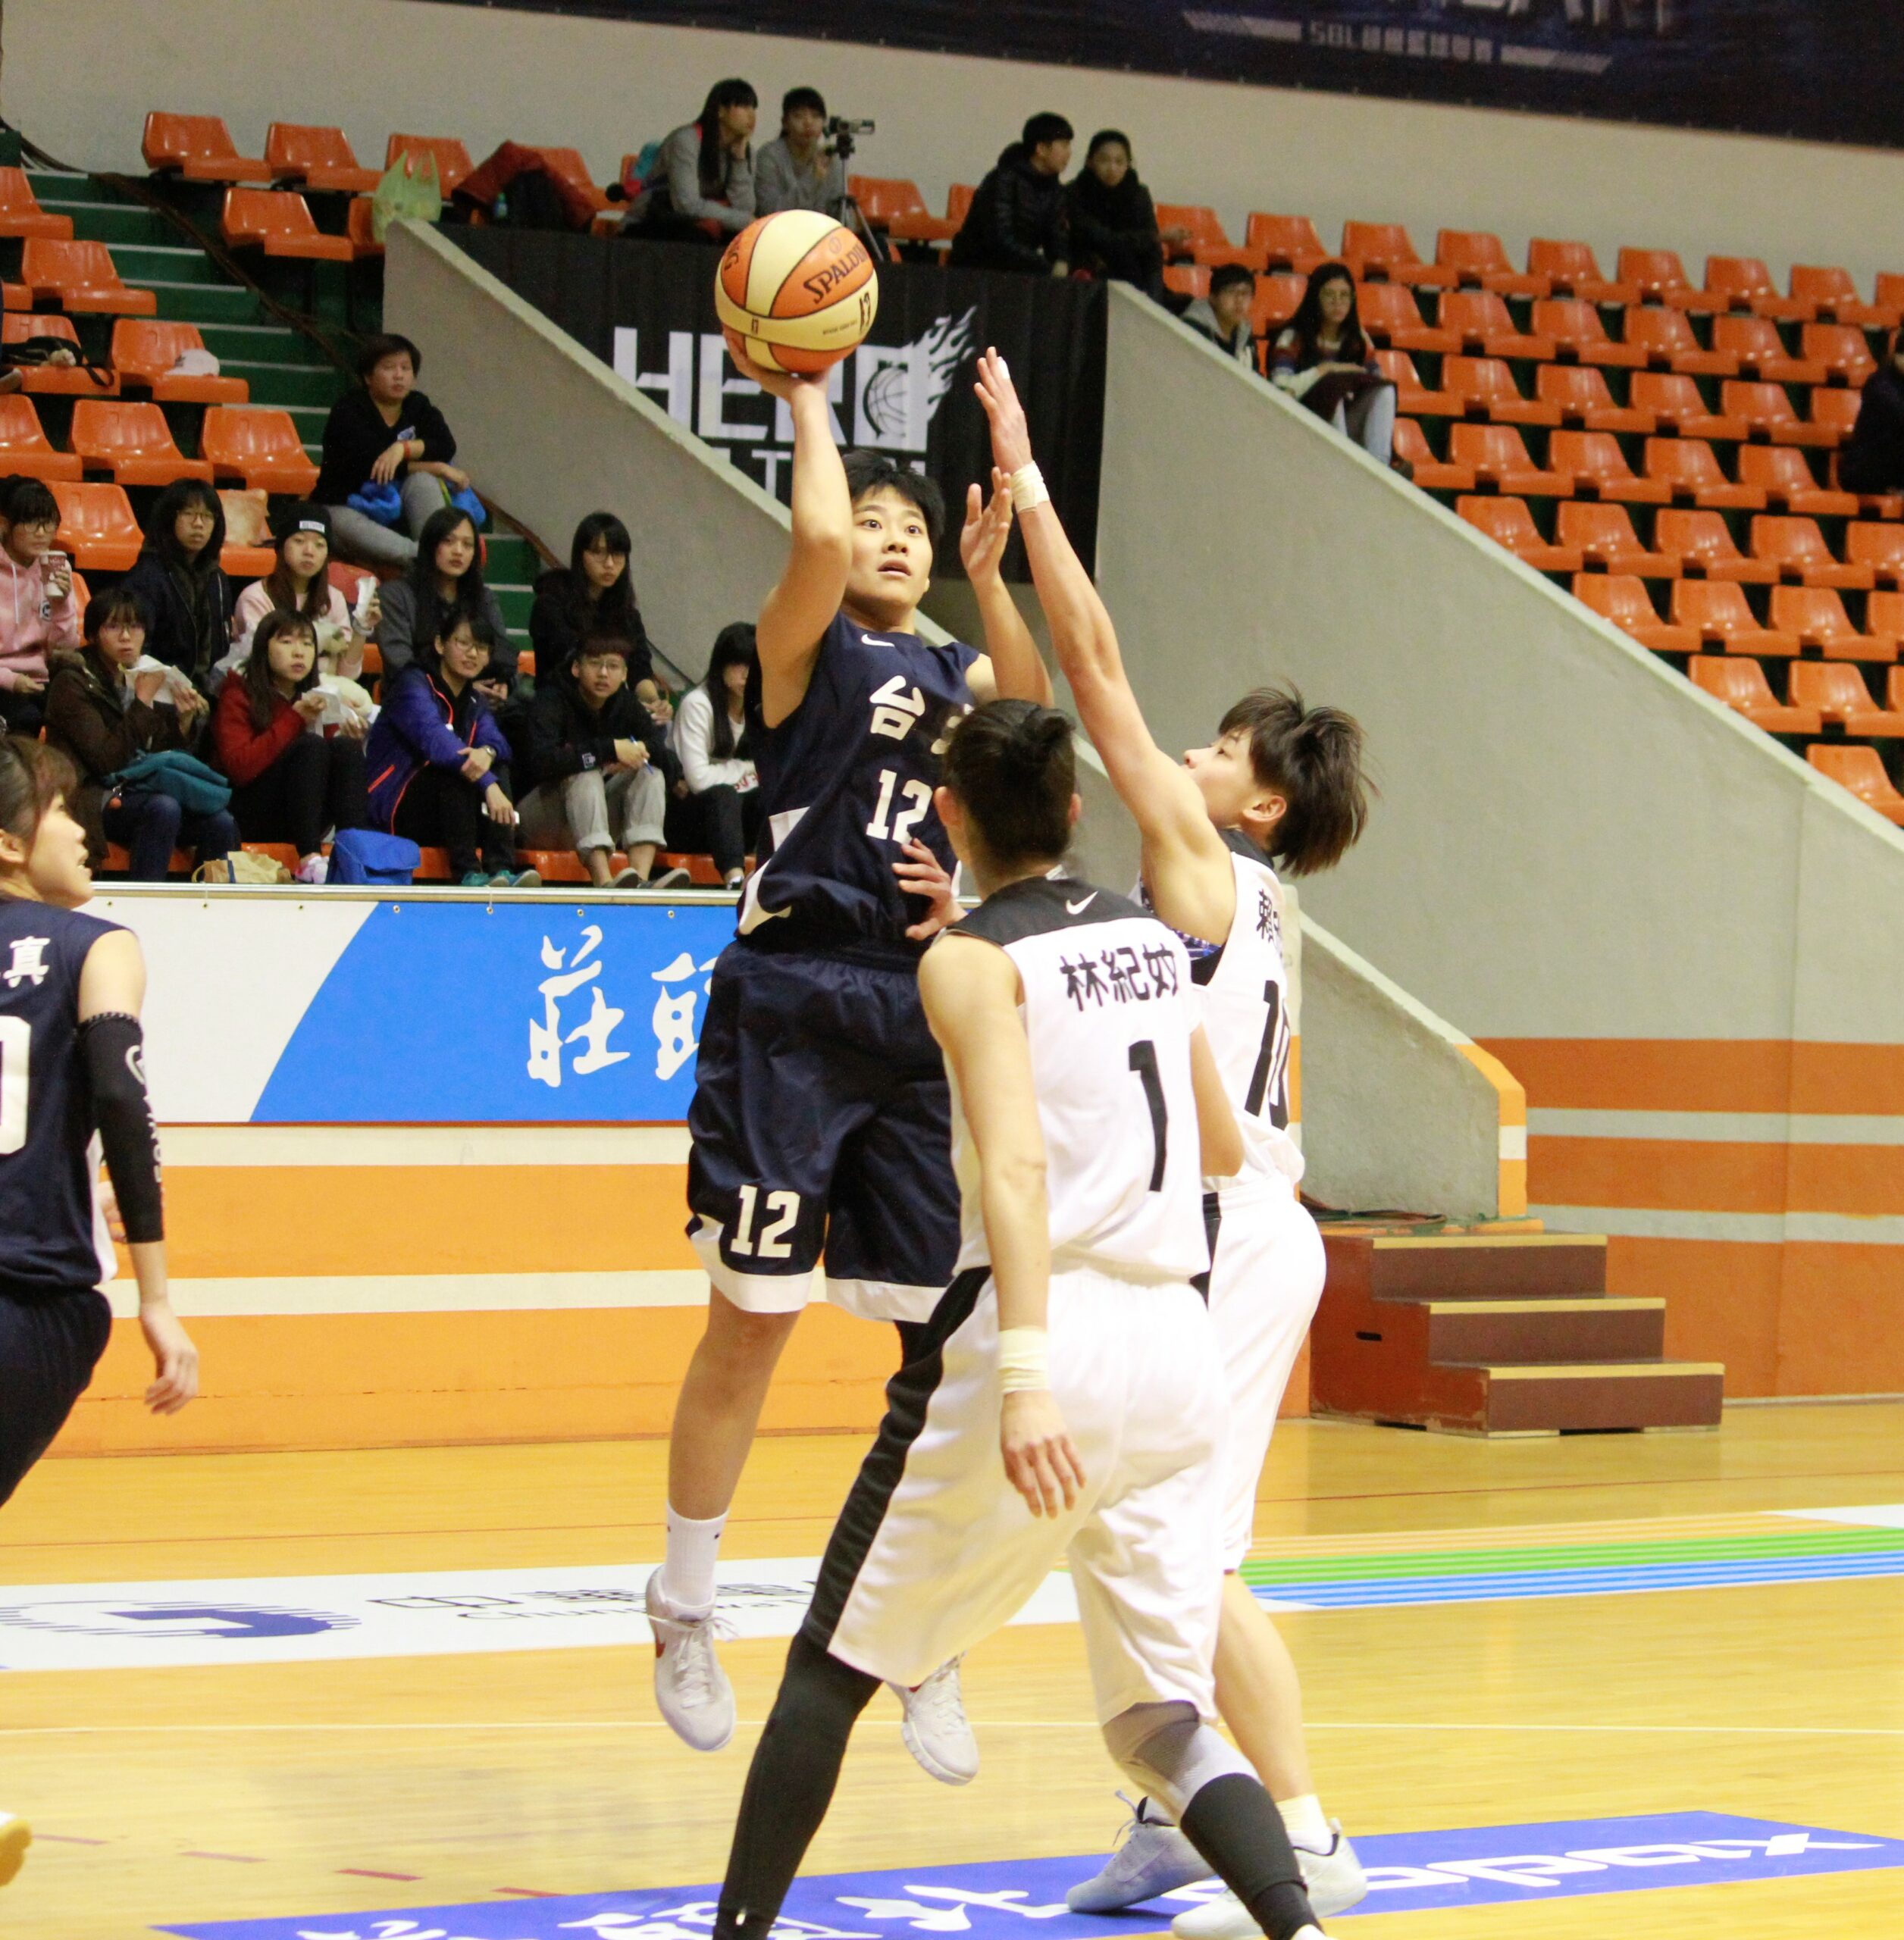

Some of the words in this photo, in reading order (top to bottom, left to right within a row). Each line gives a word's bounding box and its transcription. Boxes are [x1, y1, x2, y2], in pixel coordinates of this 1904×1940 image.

[866, 768, 933, 845] 12
[1128, 1040, 1168, 1192] 1
[730, 1184, 801, 1259] 12
